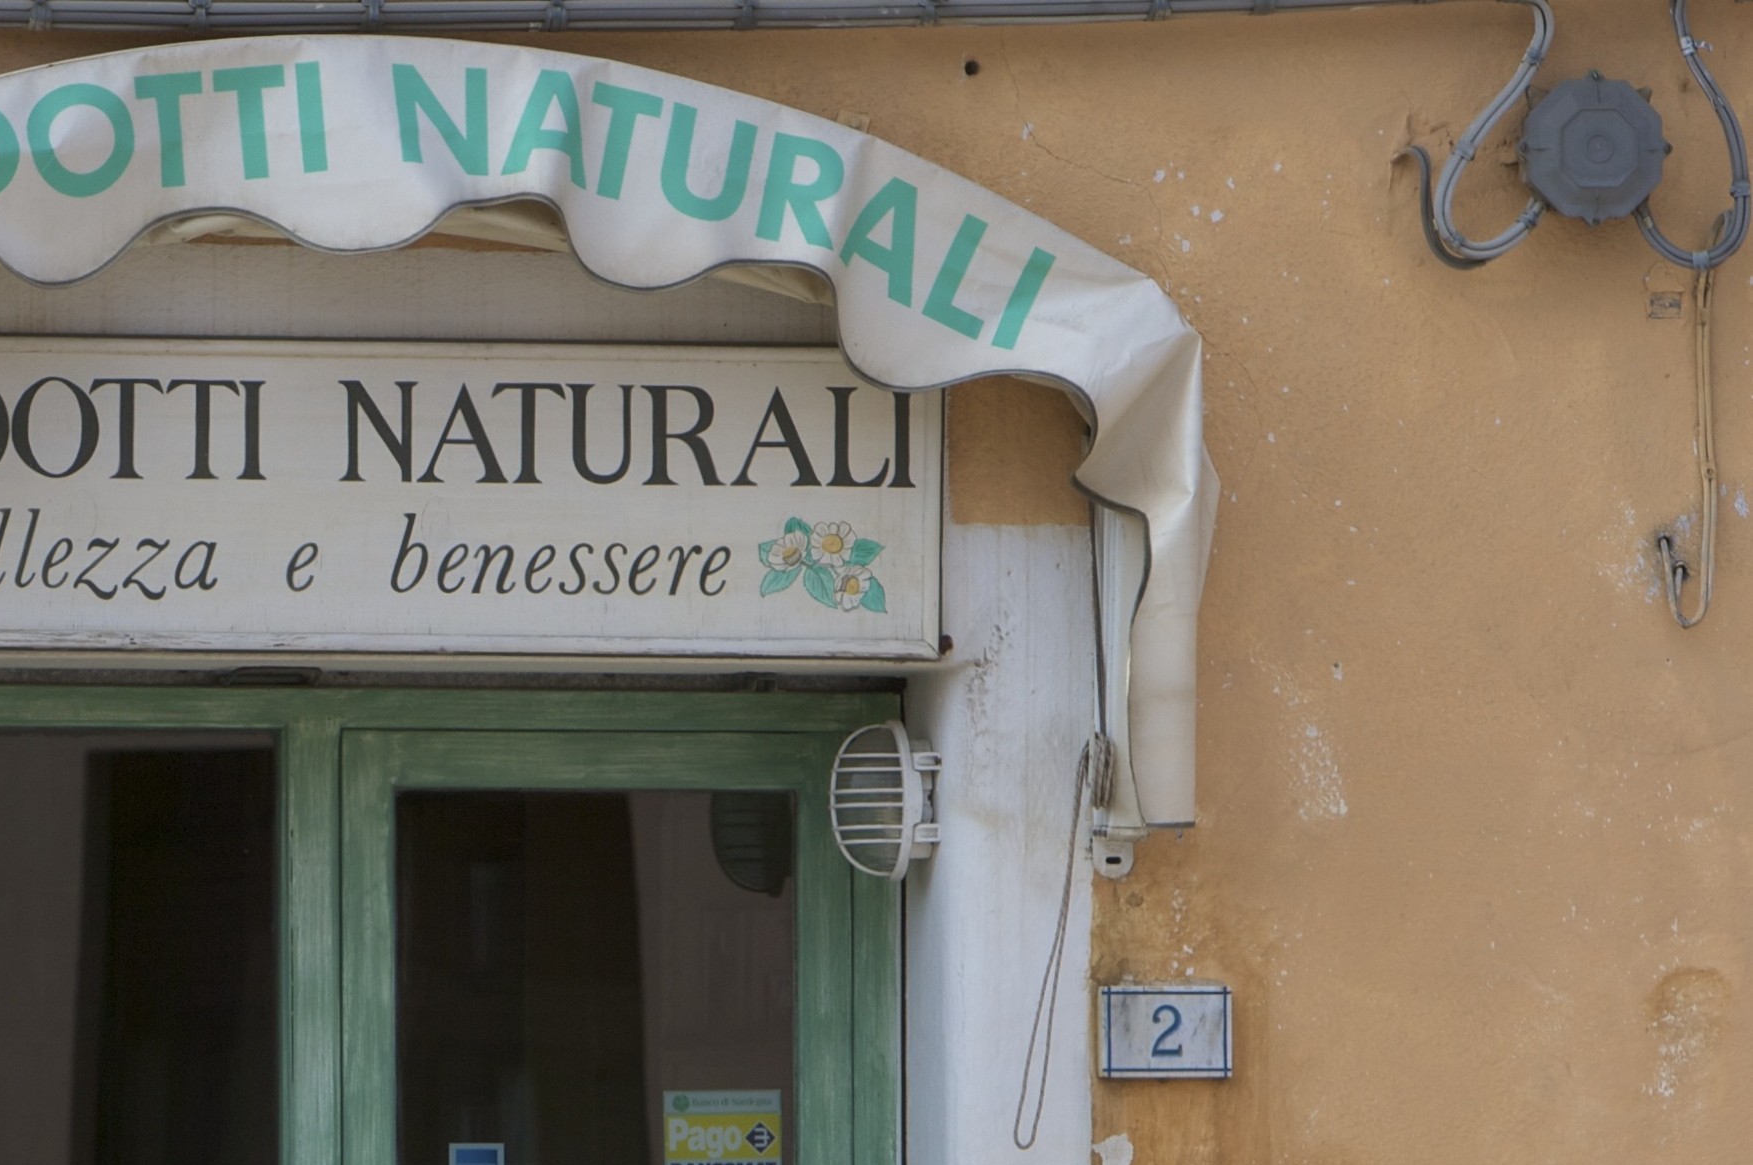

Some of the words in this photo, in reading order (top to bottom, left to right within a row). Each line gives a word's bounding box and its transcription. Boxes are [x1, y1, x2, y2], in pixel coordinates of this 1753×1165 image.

[391, 63, 1057, 351] NATURALI
[338, 380, 917, 488] NATURALI
[286, 541, 319, 592] e
[390, 513, 731, 597] benessere
[1152, 1004, 1183, 1057] 2
[668, 1118, 742, 1158] Pago
